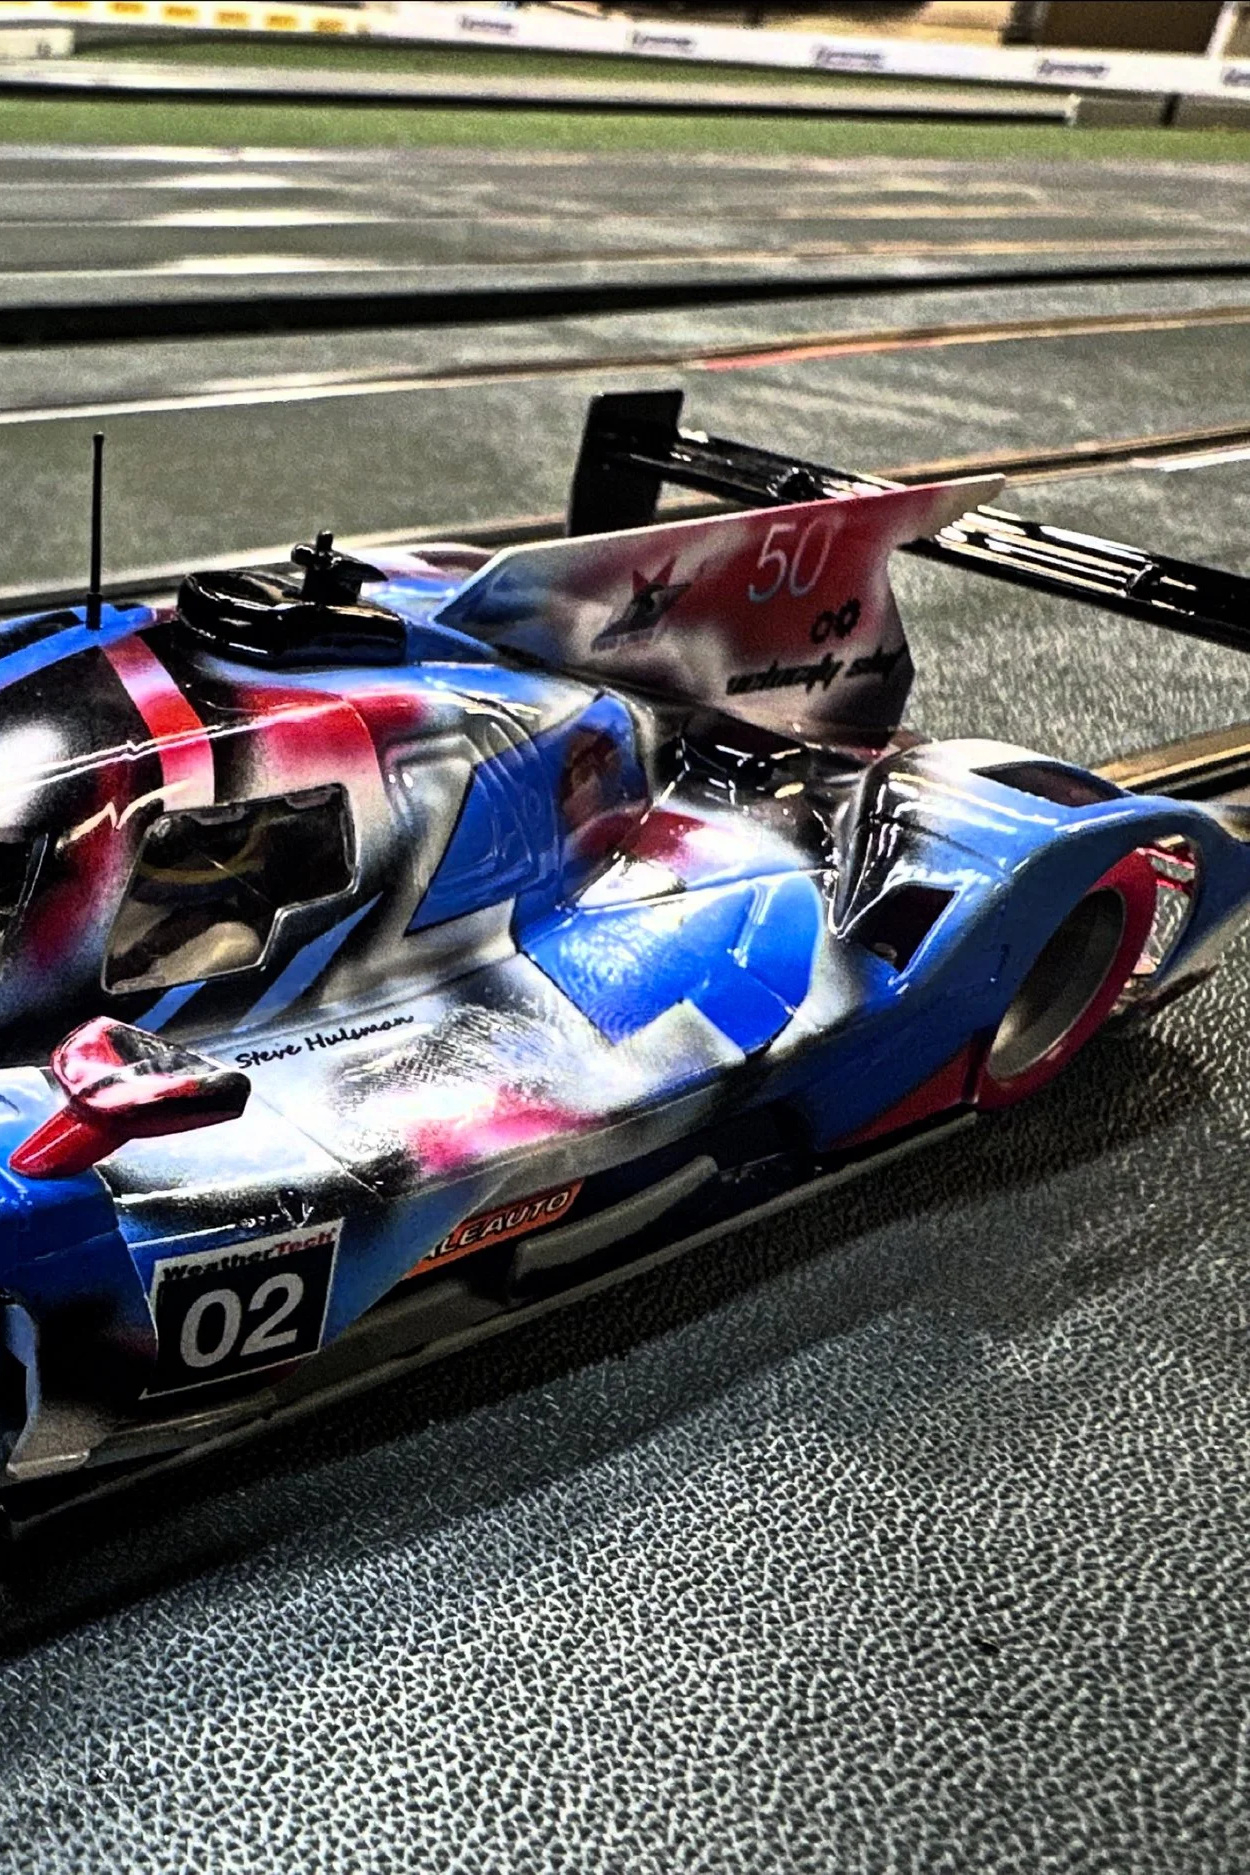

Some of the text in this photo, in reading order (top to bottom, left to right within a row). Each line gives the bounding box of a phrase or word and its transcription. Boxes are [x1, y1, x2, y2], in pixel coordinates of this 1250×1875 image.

[748, 516, 834, 602] 50
[235, 1015, 415, 1069] Steve Hulsman
[179, 1272, 304, 1368] 02
